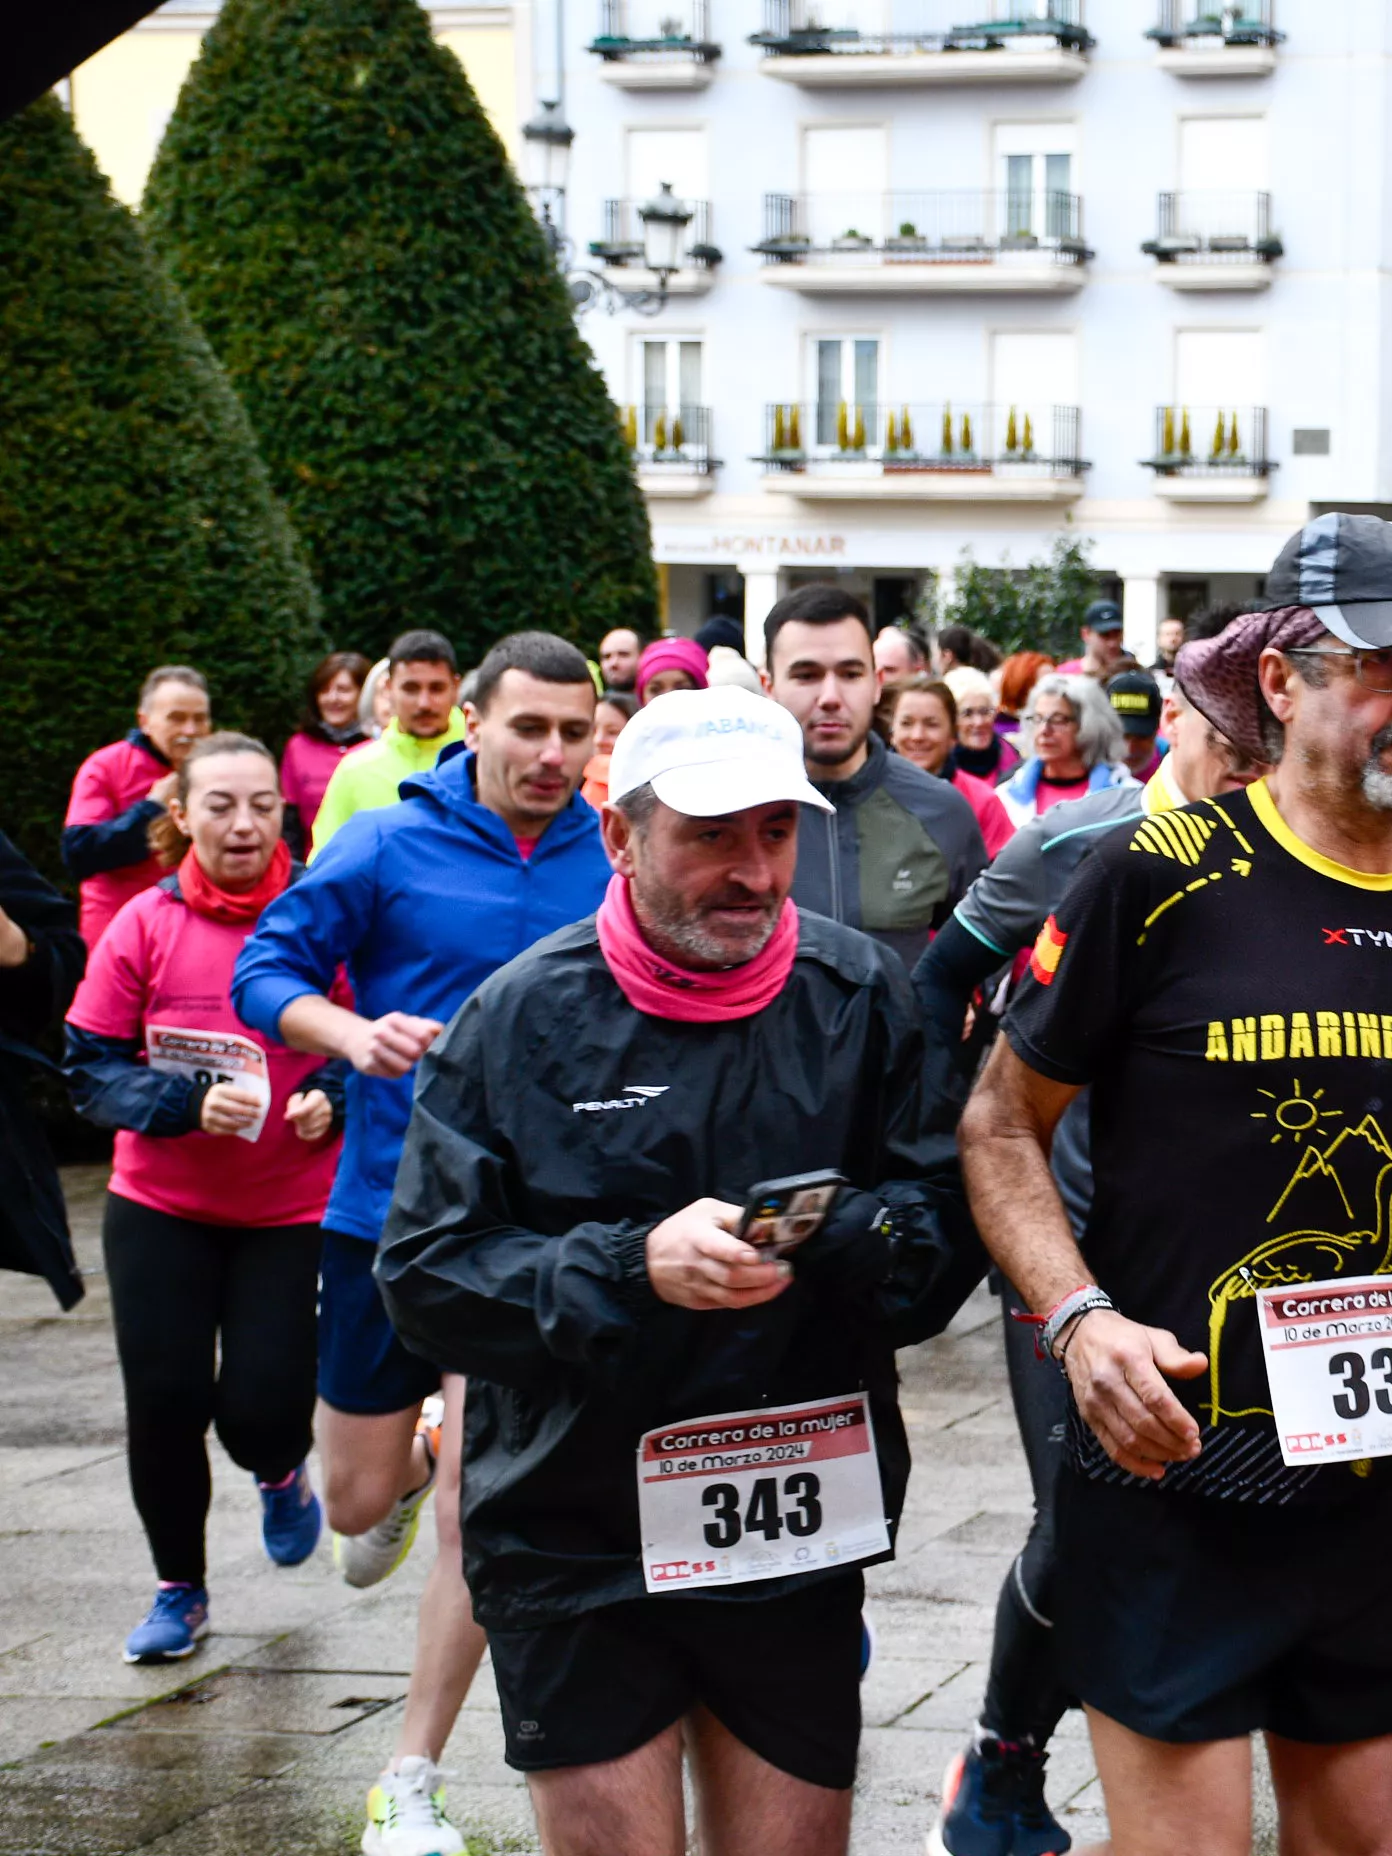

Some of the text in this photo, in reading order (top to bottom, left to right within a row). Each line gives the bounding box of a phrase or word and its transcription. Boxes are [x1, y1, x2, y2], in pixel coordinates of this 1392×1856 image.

[1282, 1294, 1366, 1317] Carrera
[1368, 1290, 1387, 1308] de
[1284, 1327, 1298, 1341] 10
[1302, 1327, 1321, 1339] de
[1326, 1321, 1382, 1337] Marzo
[661, 1412, 855, 1451] Carrera de la mujer
[660, 1442, 805, 1474] 10 de Marzo 2024
[701, 1472, 823, 1549] 343
